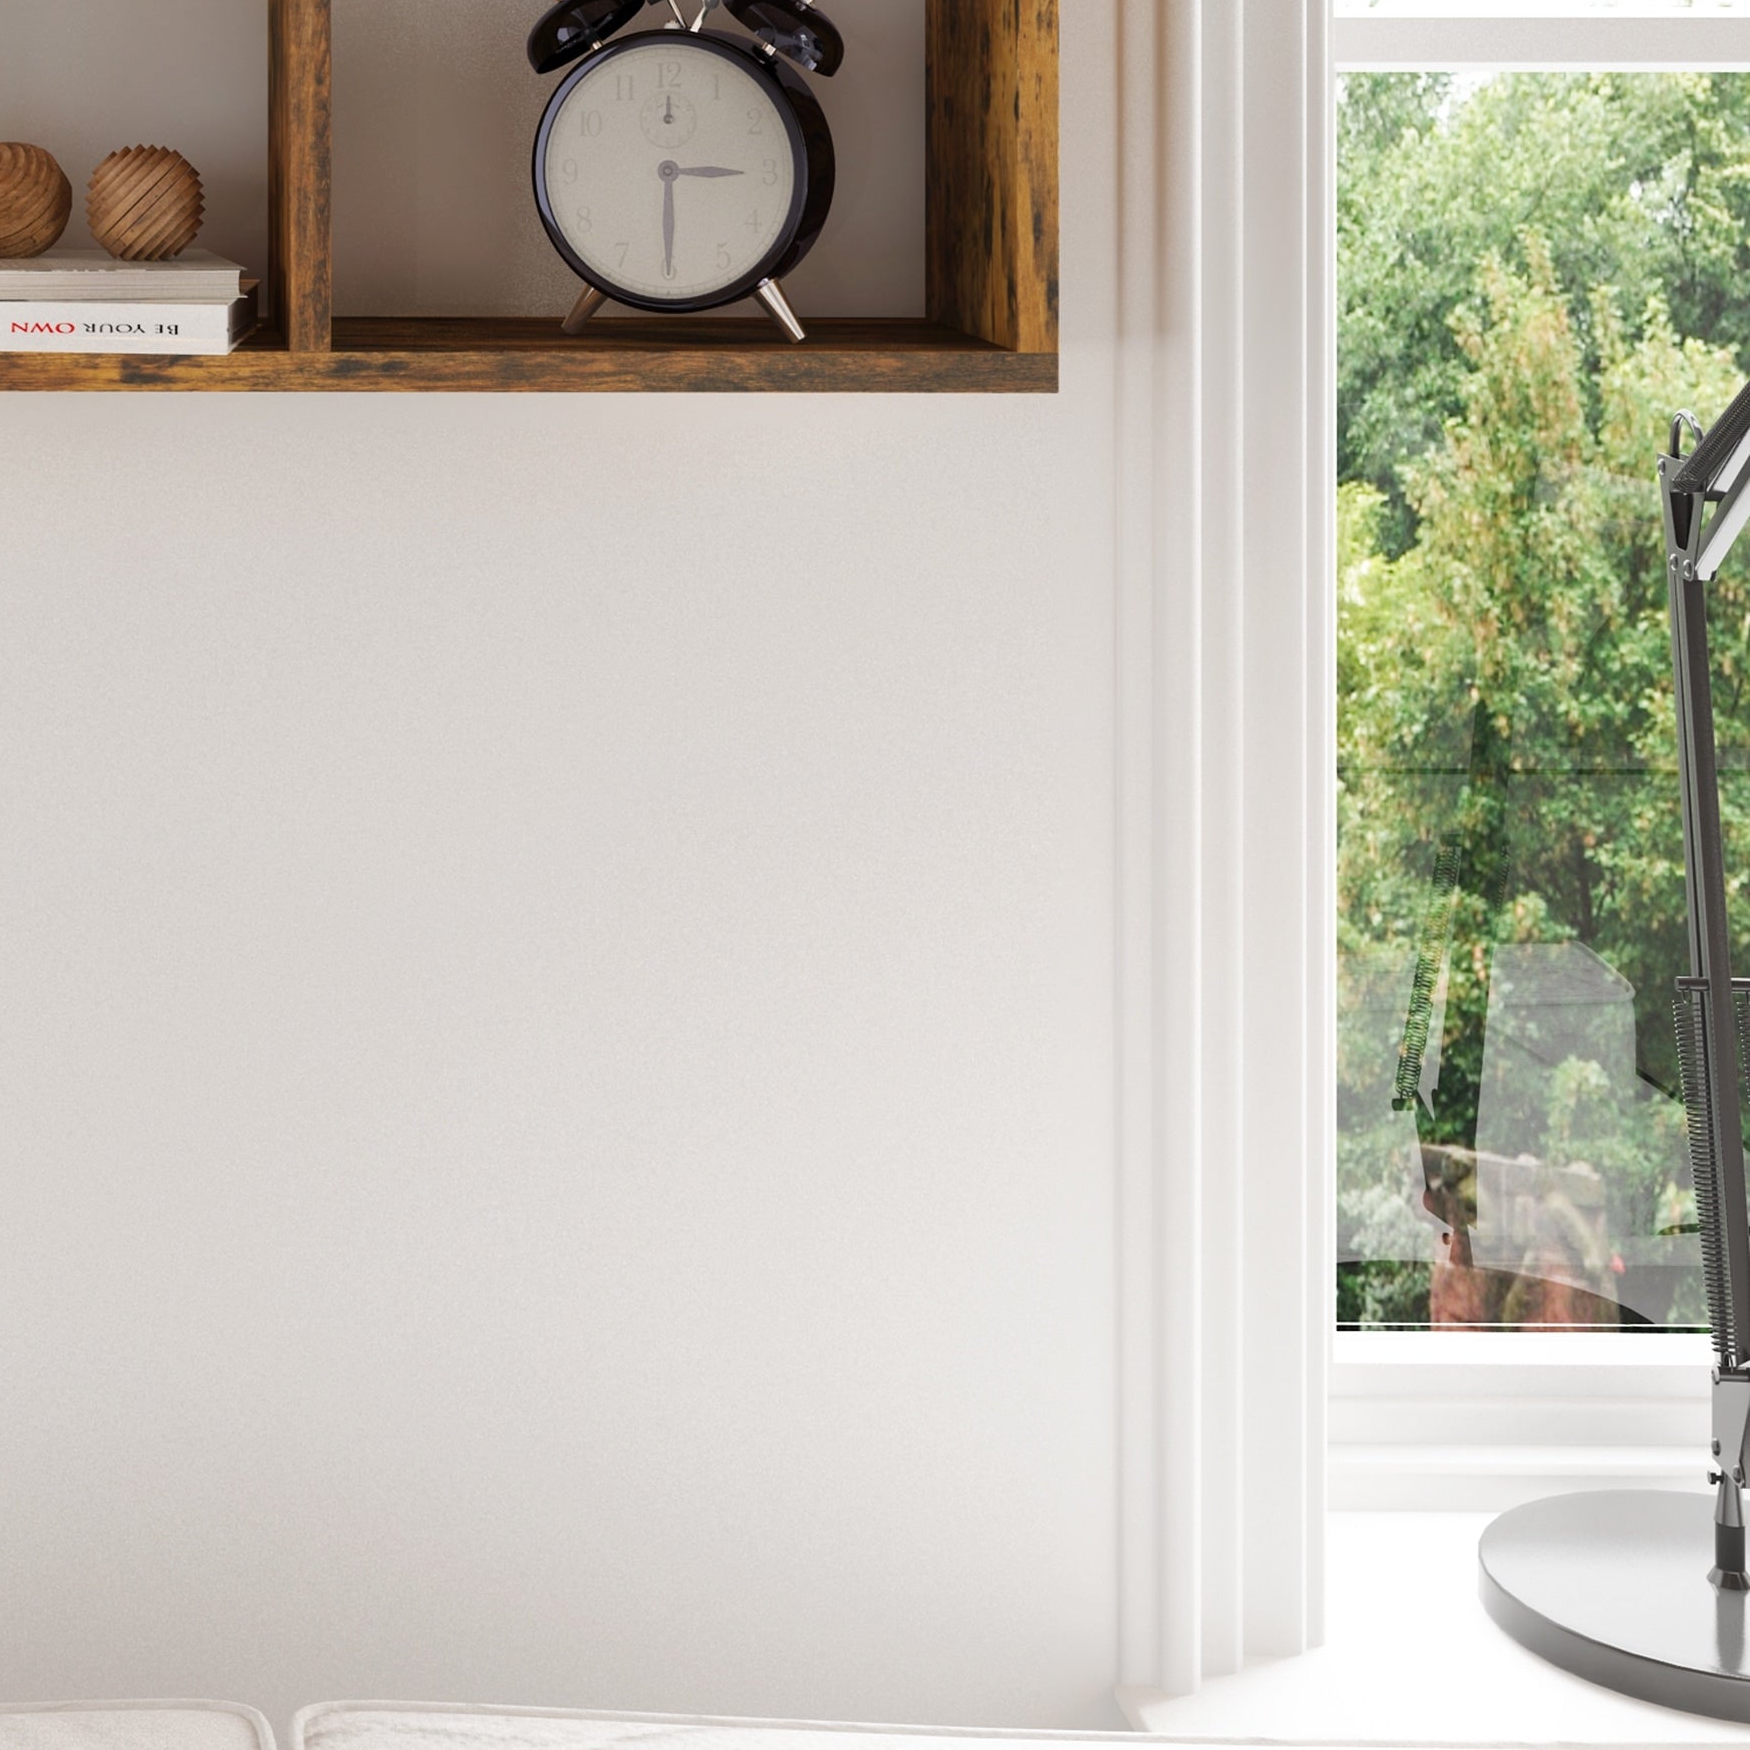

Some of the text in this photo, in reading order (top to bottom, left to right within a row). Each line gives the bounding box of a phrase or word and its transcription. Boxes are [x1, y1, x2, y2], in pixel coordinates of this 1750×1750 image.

[616, 75, 635, 100] 11
[657, 62, 682, 89] 12
[712, 76, 721, 100] 1
[579, 110, 602, 136] 10
[746, 108, 762, 135] 2
[563, 159, 578, 185] 9
[762, 159, 778, 186] 3
[576, 207, 592, 233] 8
[744, 210, 762, 234] 4
[615, 243, 629, 268] 7
[717, 243, 731, 270] 5
[11, 322, 75, 334] OWN
[83, 323, 145, 333] YOUR
[155, 324, 178, 335] BE
